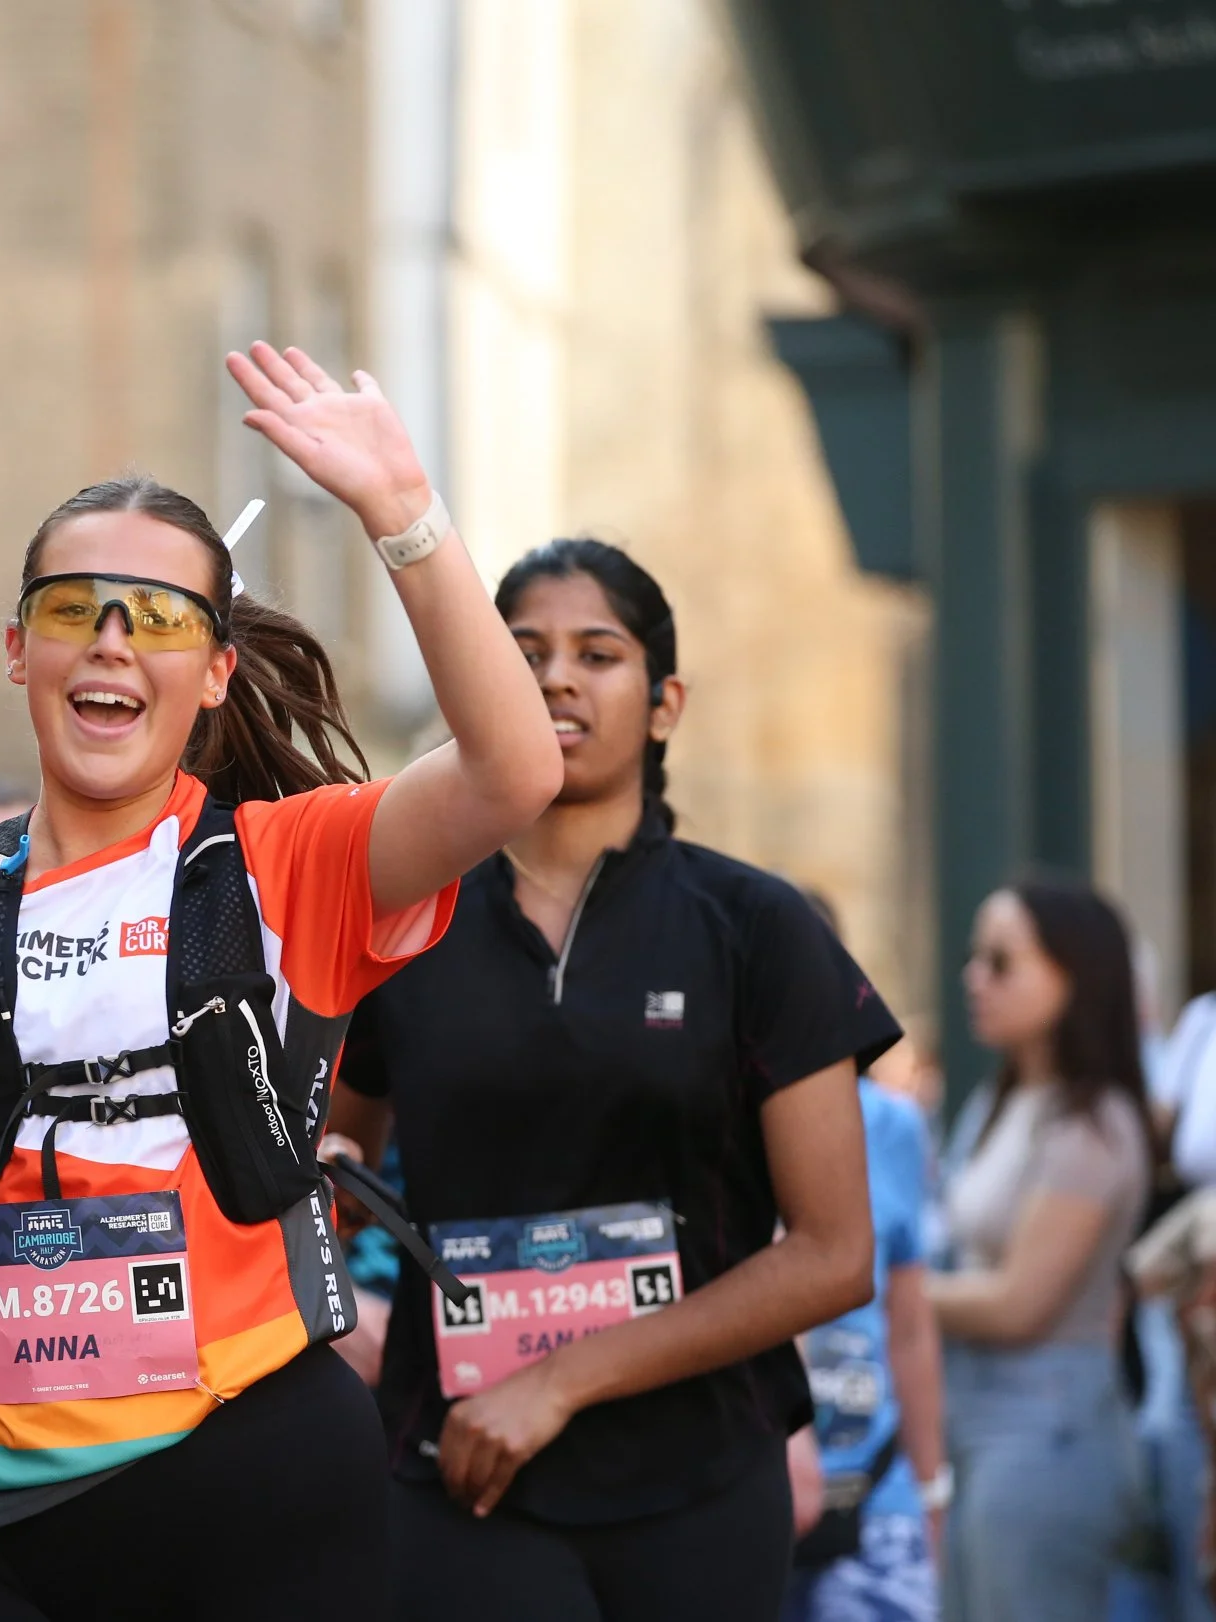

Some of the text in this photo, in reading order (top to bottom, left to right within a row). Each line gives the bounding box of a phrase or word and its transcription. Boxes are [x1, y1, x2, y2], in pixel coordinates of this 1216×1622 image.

[127, 919, 159, 937] FOR
[125, 931, 169, 951] CUR
[262, 1103, 286, 1147] outdoor
[99, 1213, 147, 1223] ALZHEIMER'S
[108, 1220, 147, 1229] RESEARCH
[151, 1221, 169, 1229] CURE
[18, 1232, 77, 1249] CAMBRIDGE
[30, 1249, 66, 1266] MARATHON
[40, 1246, 55, 1255] HALF
[490, 1278, 628, 1320] M.12943
[13, 1334, 100, 1364] ANNA
[150, 1371, 186, 1382] Gearset
